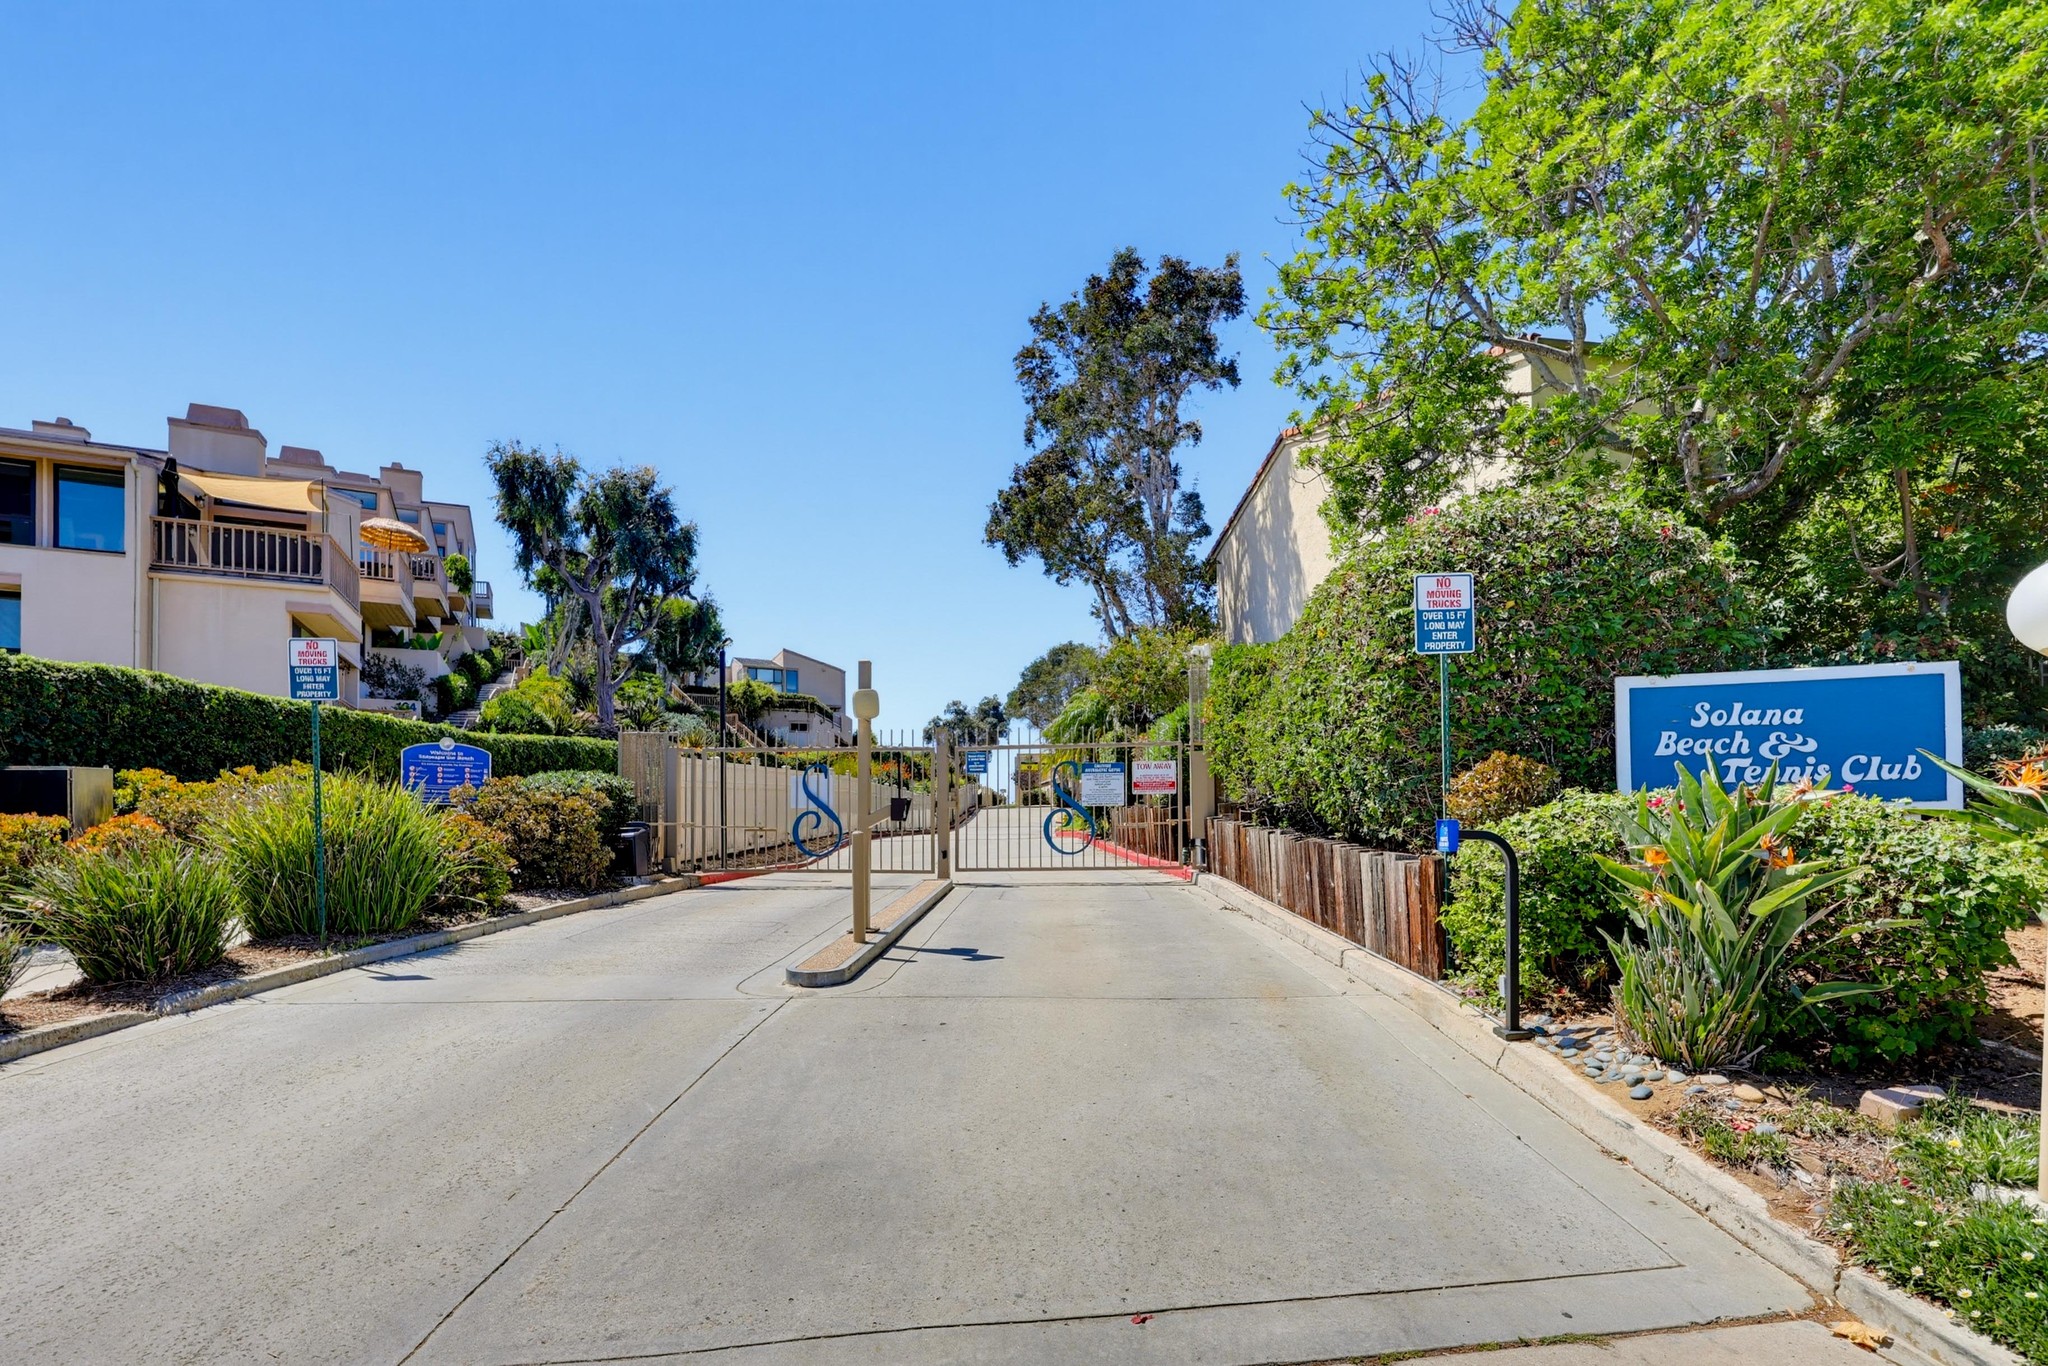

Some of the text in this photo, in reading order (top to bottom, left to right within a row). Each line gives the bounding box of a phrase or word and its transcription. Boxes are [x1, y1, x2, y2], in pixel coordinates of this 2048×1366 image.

[1436, 578, 1451, 588] NO
[1427, 590, 1461, 599] MOVING
[1427, 600, 1461, 608] TRUCKS
[1423, 611, 1466, 620] OVER 15 FT
[1424, 621, 1466, 630] LONG MAY
[1432, 631, 1458, 640] ENTER
[306, 641, 318, 650] NO
[1424, 641, 1466, 650] PROPERTY
[1690, 702, 1804, 728] Solana
[1654, 730, 1818, 760] Beach &
[1721, 755, 1922, 785] Tennis Club
